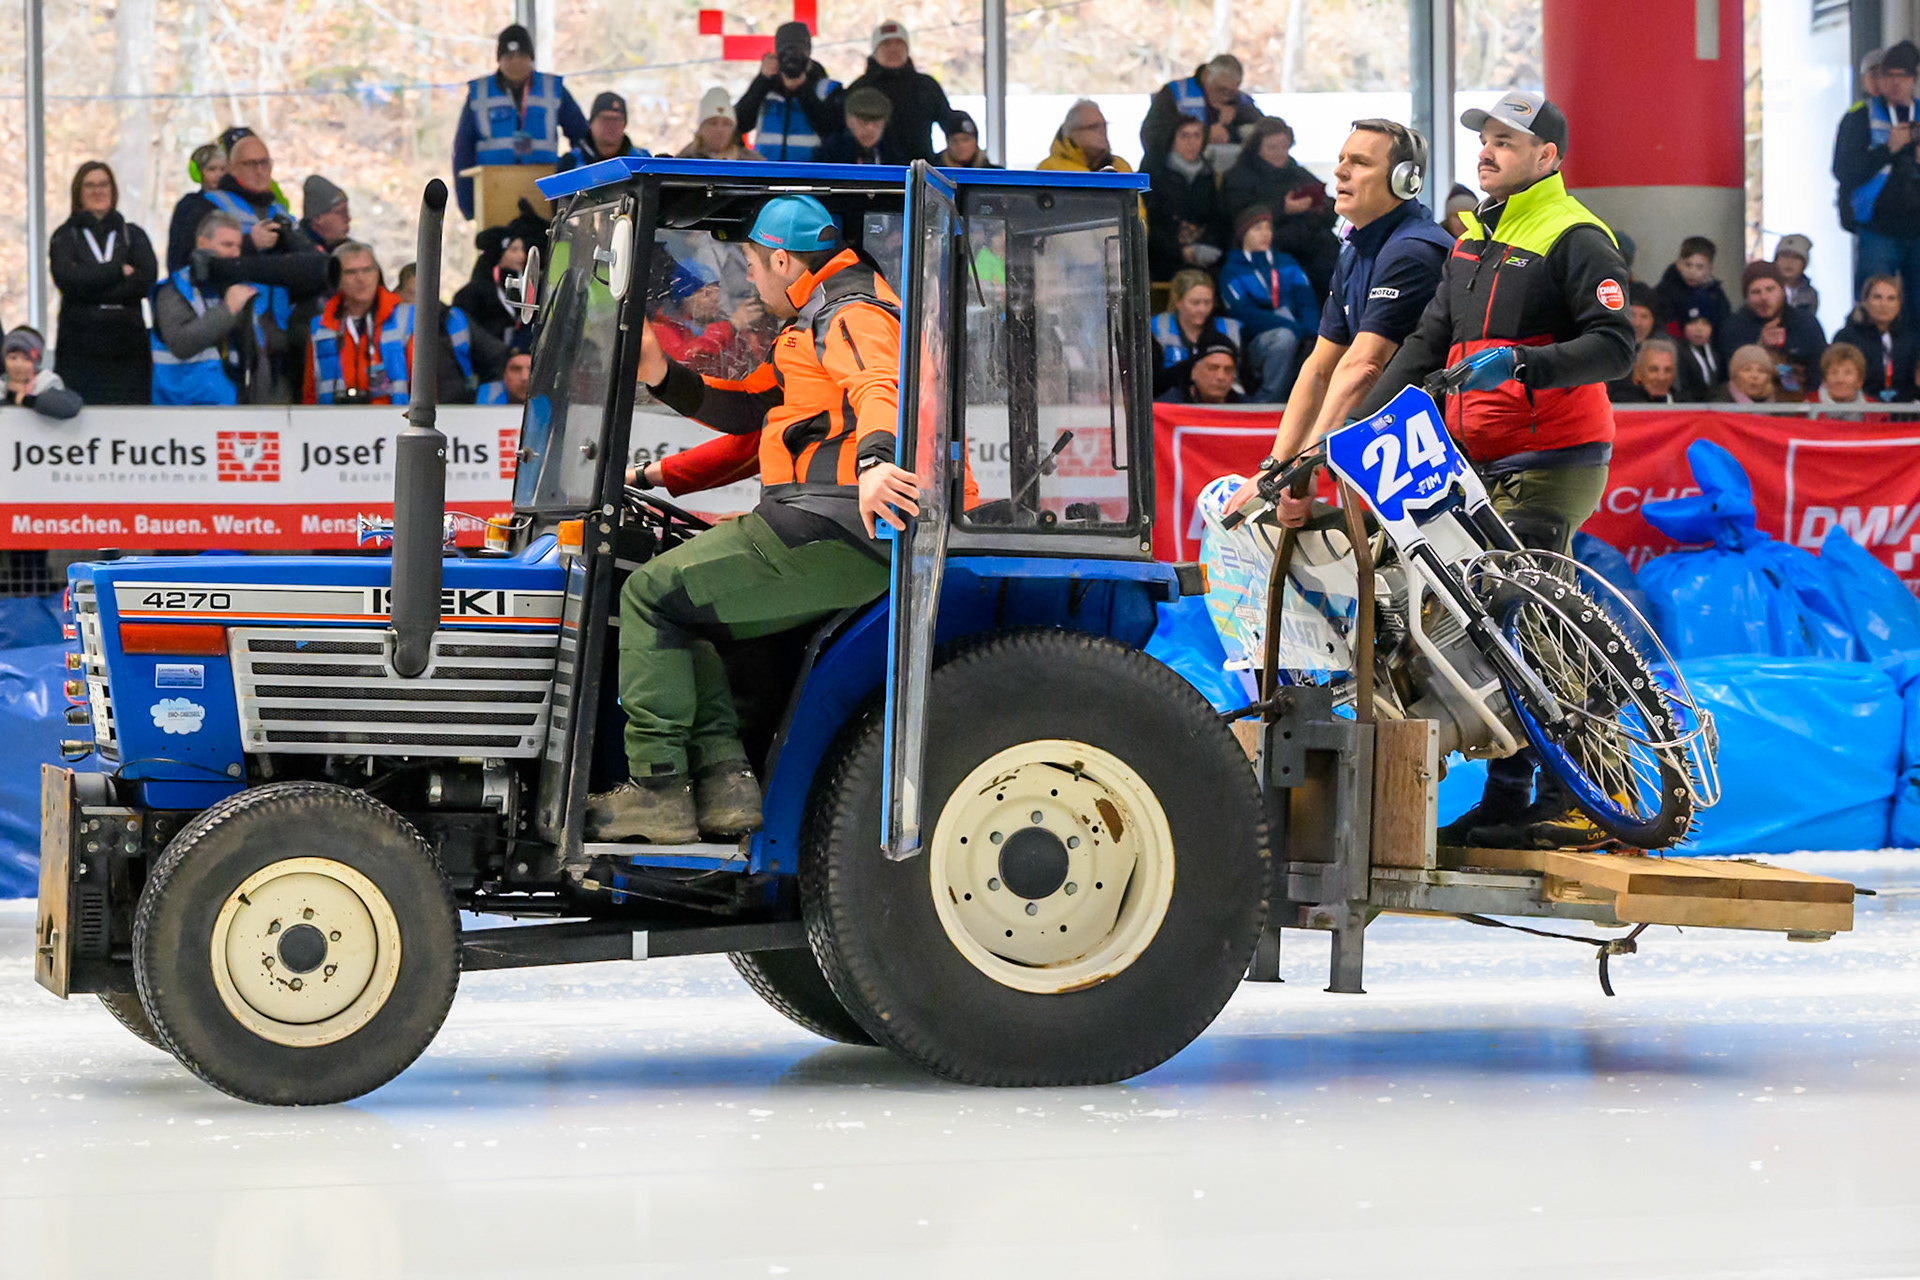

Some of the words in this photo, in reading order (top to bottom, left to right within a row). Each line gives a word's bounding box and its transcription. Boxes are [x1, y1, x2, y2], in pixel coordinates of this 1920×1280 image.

[12, 437, 101, 472] Josef
[111, 438, 207, 466] Fuchs
[301, 437, 386, 472] Josef
[1361, 409, 1447, 506] 24
[51, 470, 208, 483] Bauunternehmen
[1415, 472, 1442, 496] FIM
[11, 514, 129, 535] Menschen.
[134, 514, 208, 535] Bauen.
[212, 515, 282, 535] Werte.
[142, 592, 231, 610] 4270
[372, 588, 506, 616] IEKI
